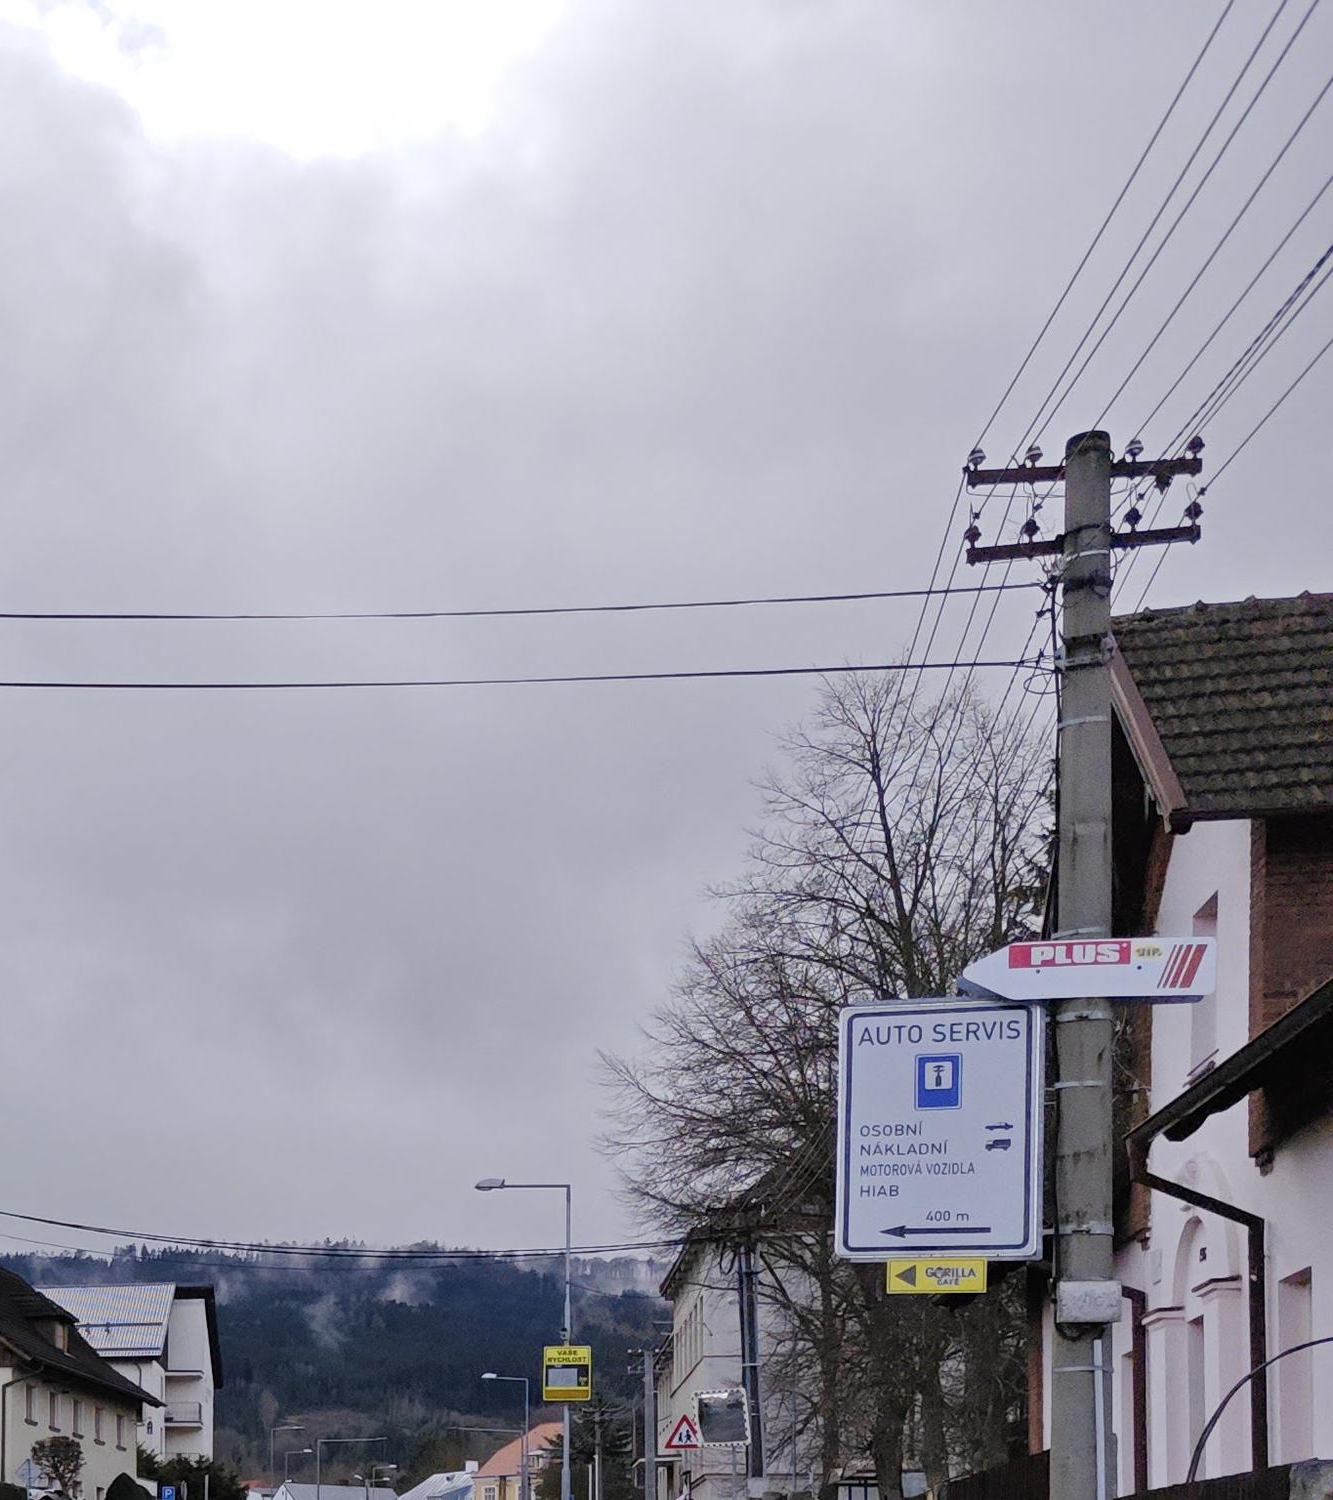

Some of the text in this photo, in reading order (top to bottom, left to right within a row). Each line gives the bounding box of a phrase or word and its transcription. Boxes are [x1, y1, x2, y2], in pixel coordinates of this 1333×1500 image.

[1030, 943, 1121, 966] PLUS
[858, 1020, 1021, 1047] AUTO SERVIS
[859, 1121, 923, 1138] OSOBNÍ
[859, 1140, 948, 1157] NÁKLADNÍ
[859, 1160, 975, 1177] MOTOROVÁ VOZIDLA
[859, 1184, 900, 1198] HIAB
[925, 1209, 969, 1222] 400 m
[925, 1266, 976, 1279] GORILLA
